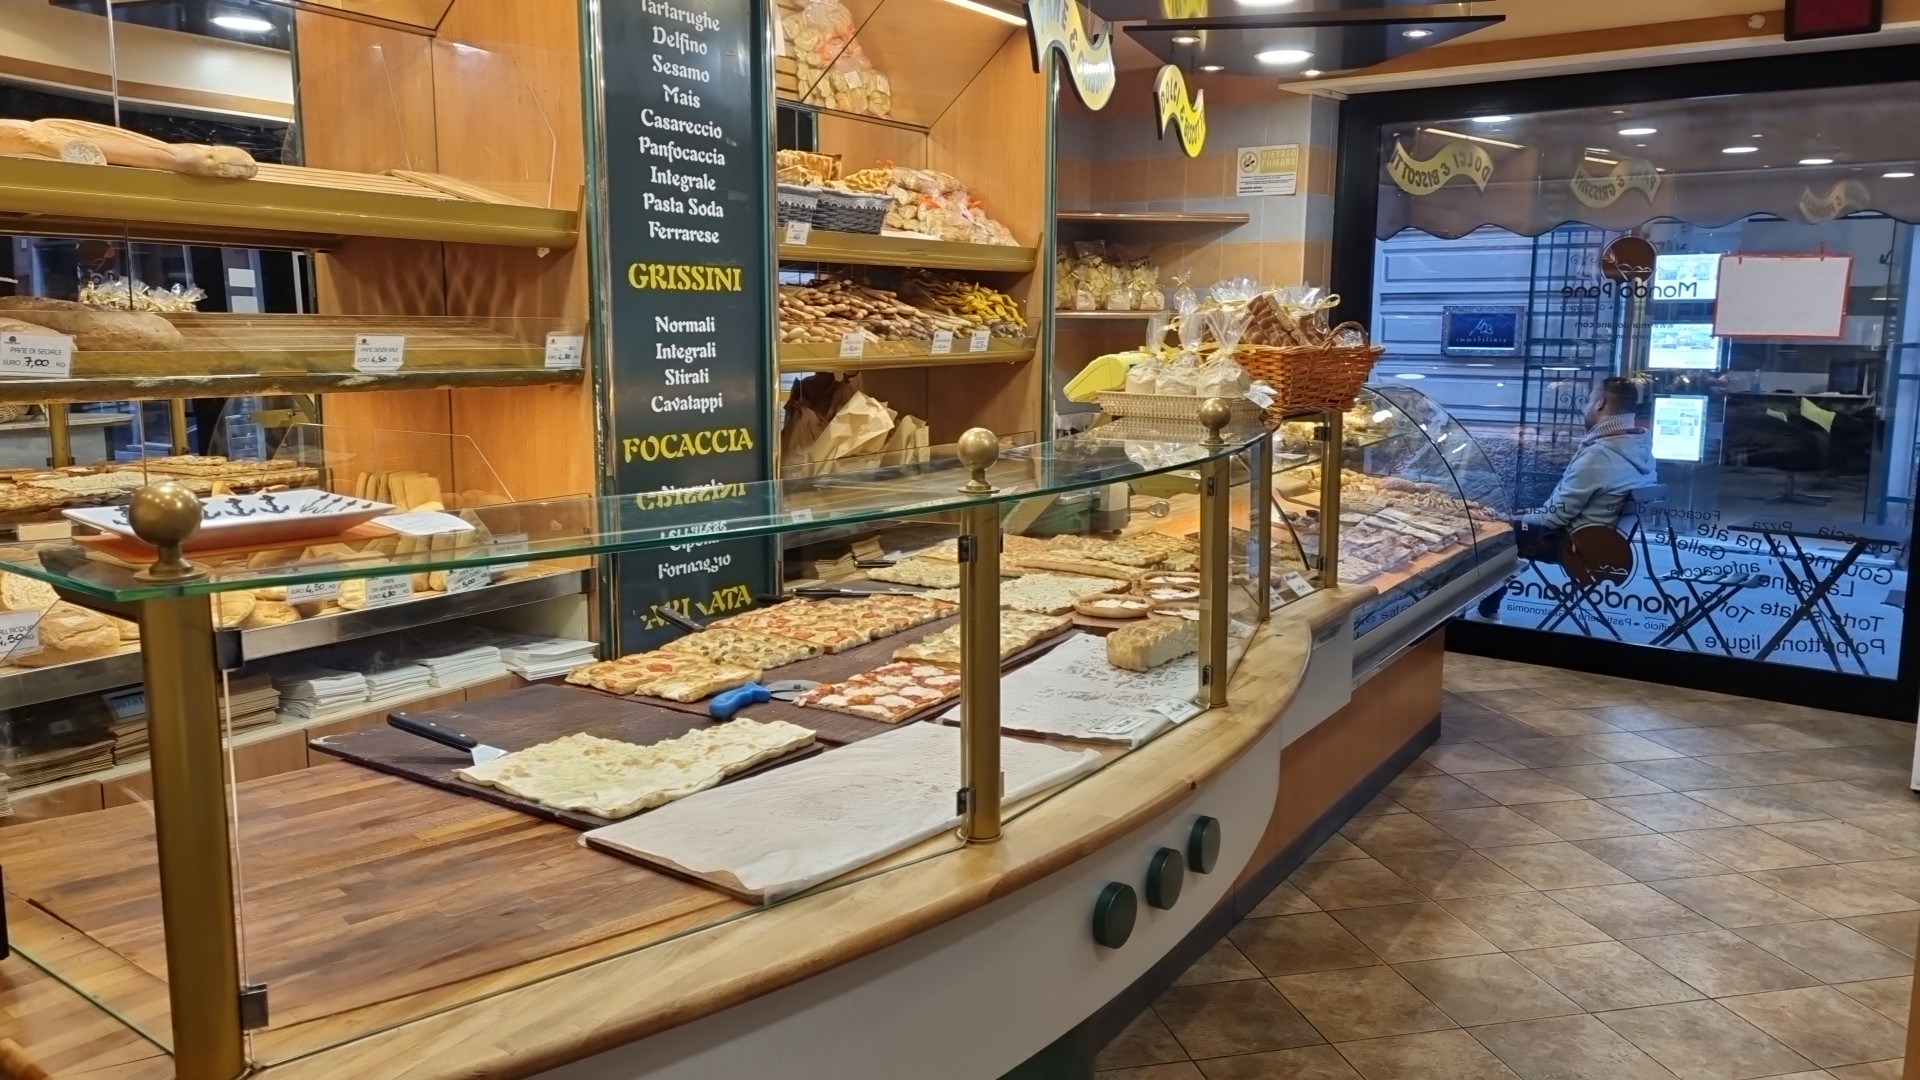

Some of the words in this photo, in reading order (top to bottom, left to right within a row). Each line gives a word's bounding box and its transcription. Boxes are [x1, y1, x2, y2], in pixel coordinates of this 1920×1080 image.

[653, 26, 707, 55] Delfino
[652, 55, 709, 82] Sesamo
[663, 85, 700, 108] Mais
[641, 108, 722, 139] Casareccio
[639, 137, 725, 166] Panfocaccia
[1262, 150, 1296, 158] VIETATO
[1262, 158, 1296, 168] FUMARE
[650, 166, 716, 191] Integrale
[643, 193, 684, 215] Pasta
[688, 198, 723, 218] Soda
[649, 221, 720, 243] Ferrarese
[628, 262, 742, 292] GRISSINI
[655, 316, 716, 333] Normali
[10, 347, 27, 355] PANE
[656, 342, 717, 363] Integrali
[24, 357, 49, 369] 7,00
[665, 368, 709, 385] Stirati
[651, 393, 723, 413] Cavatappi
[622, 428, 753, 464] FOCACCIA
[305, 583, 326, 594] 4,50
[638, 585, 752, 631] ARIATA
